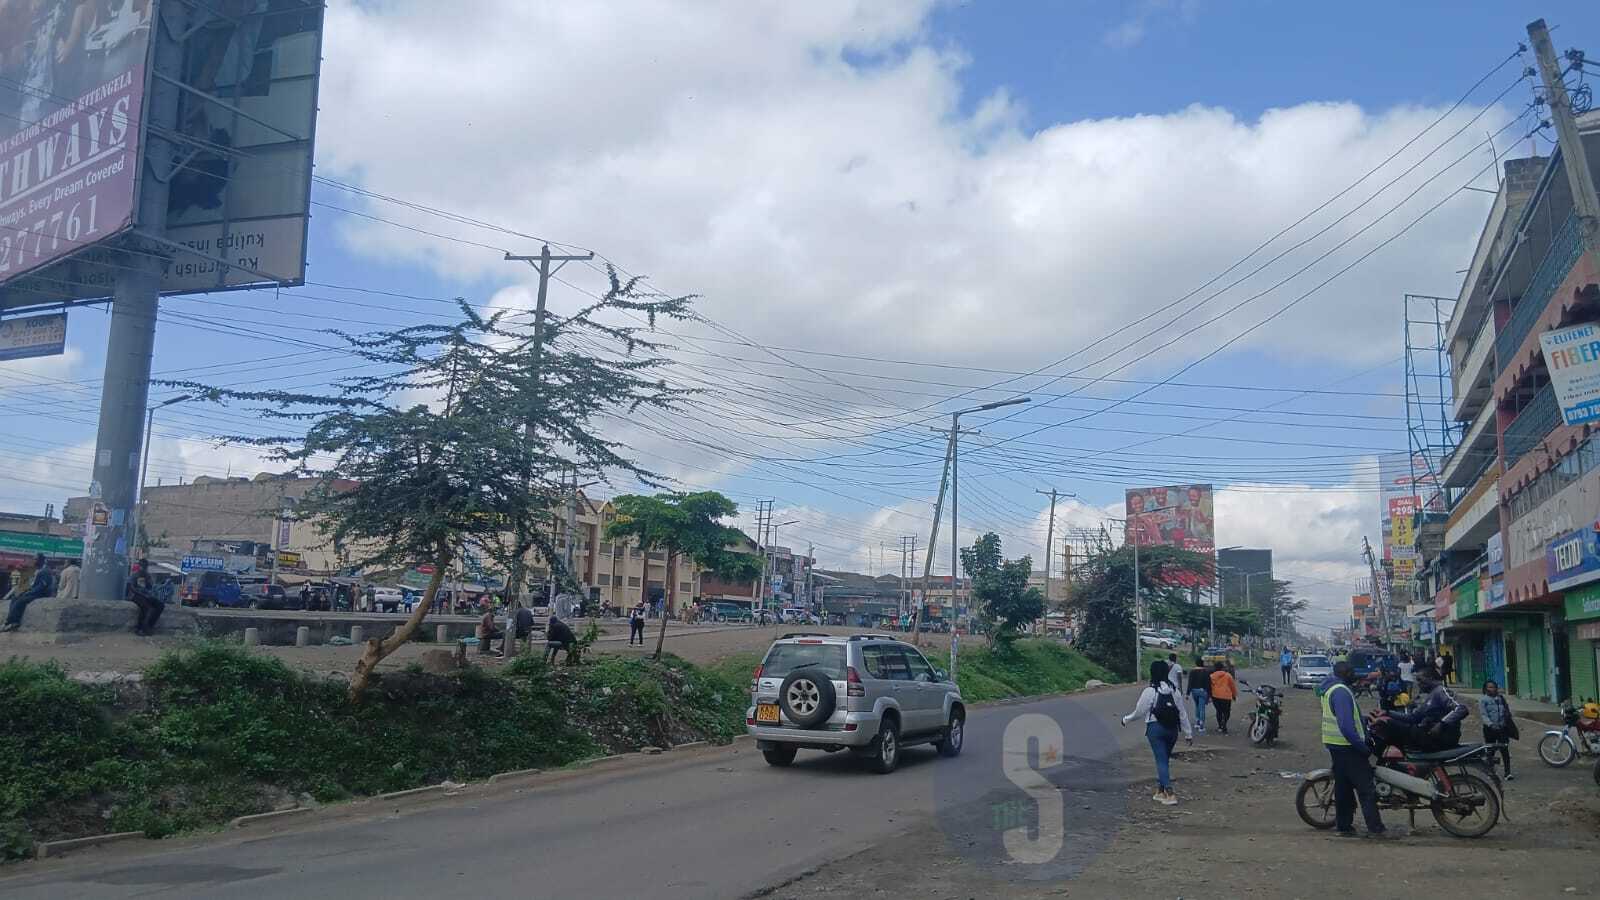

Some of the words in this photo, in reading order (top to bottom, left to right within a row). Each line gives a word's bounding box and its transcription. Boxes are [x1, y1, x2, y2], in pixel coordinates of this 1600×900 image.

[42, 102, 76, 132] SCHOOL
[78, 71, 132, 111] KITENGELA
[29, 193, 52, 214] Every
[55, 179, 84, 202] Dream
[86, 154, 125, 186] Covered
[1553, 537, 1582, 573] TECNO
